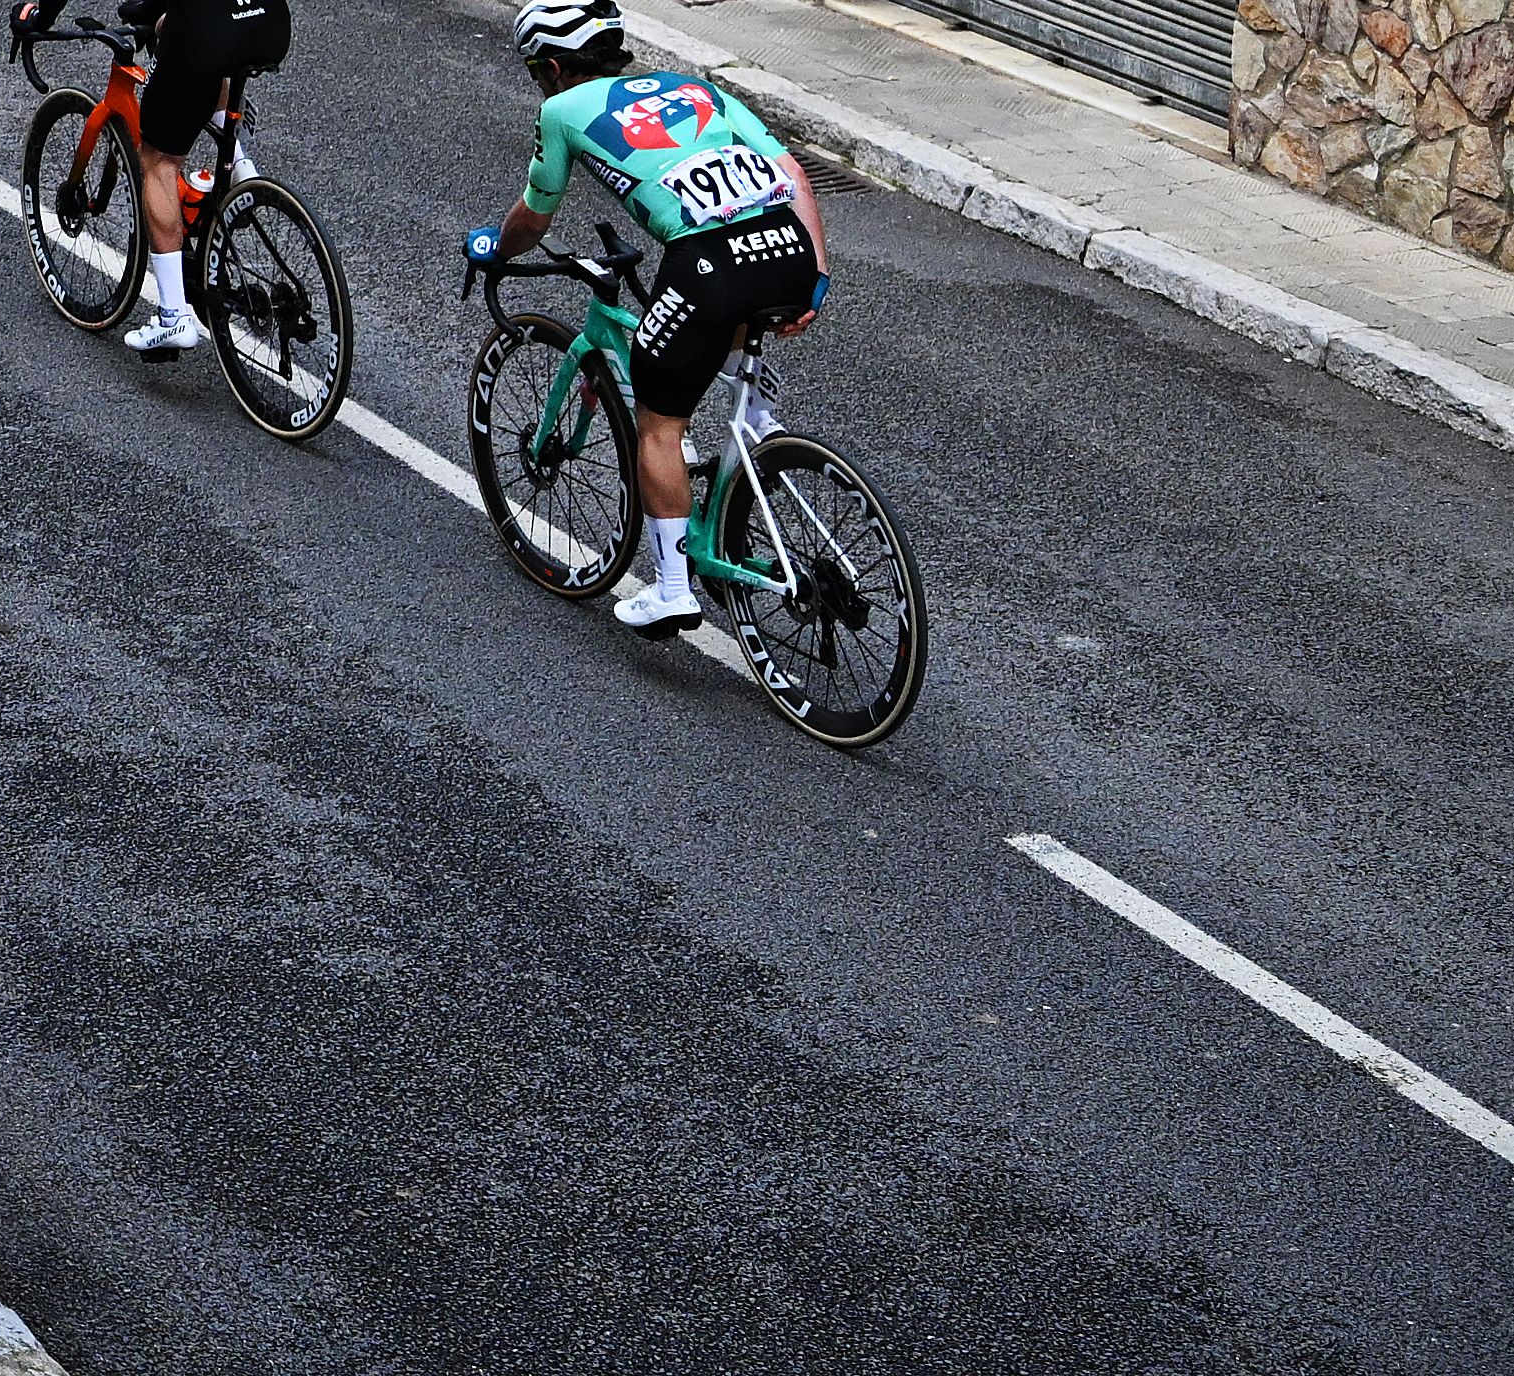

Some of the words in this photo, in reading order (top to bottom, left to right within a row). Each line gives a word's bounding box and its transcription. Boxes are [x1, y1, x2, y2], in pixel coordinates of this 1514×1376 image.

[241, 99, 258, 137] 207
[611, 87, 714, 128] KERN
[581, 150, 633, 195] FINISHER
[672, 158, 740, 210] 197
[734, 152, 777, 191] 19
[24, 184, 50, 276] LIMITED
[727, 224, 799, 255] KERN
[208, 250, 220, 286] NO
[734, 245, 805, 265] PHARMA
[47, 274, 66, 304] NO
[635, 287, 685, 349] KERN
[651, 303, 696, 357] PHARMA
[757, 363, 781, 404] 197
[563, 482, 628, 588] CADEX
